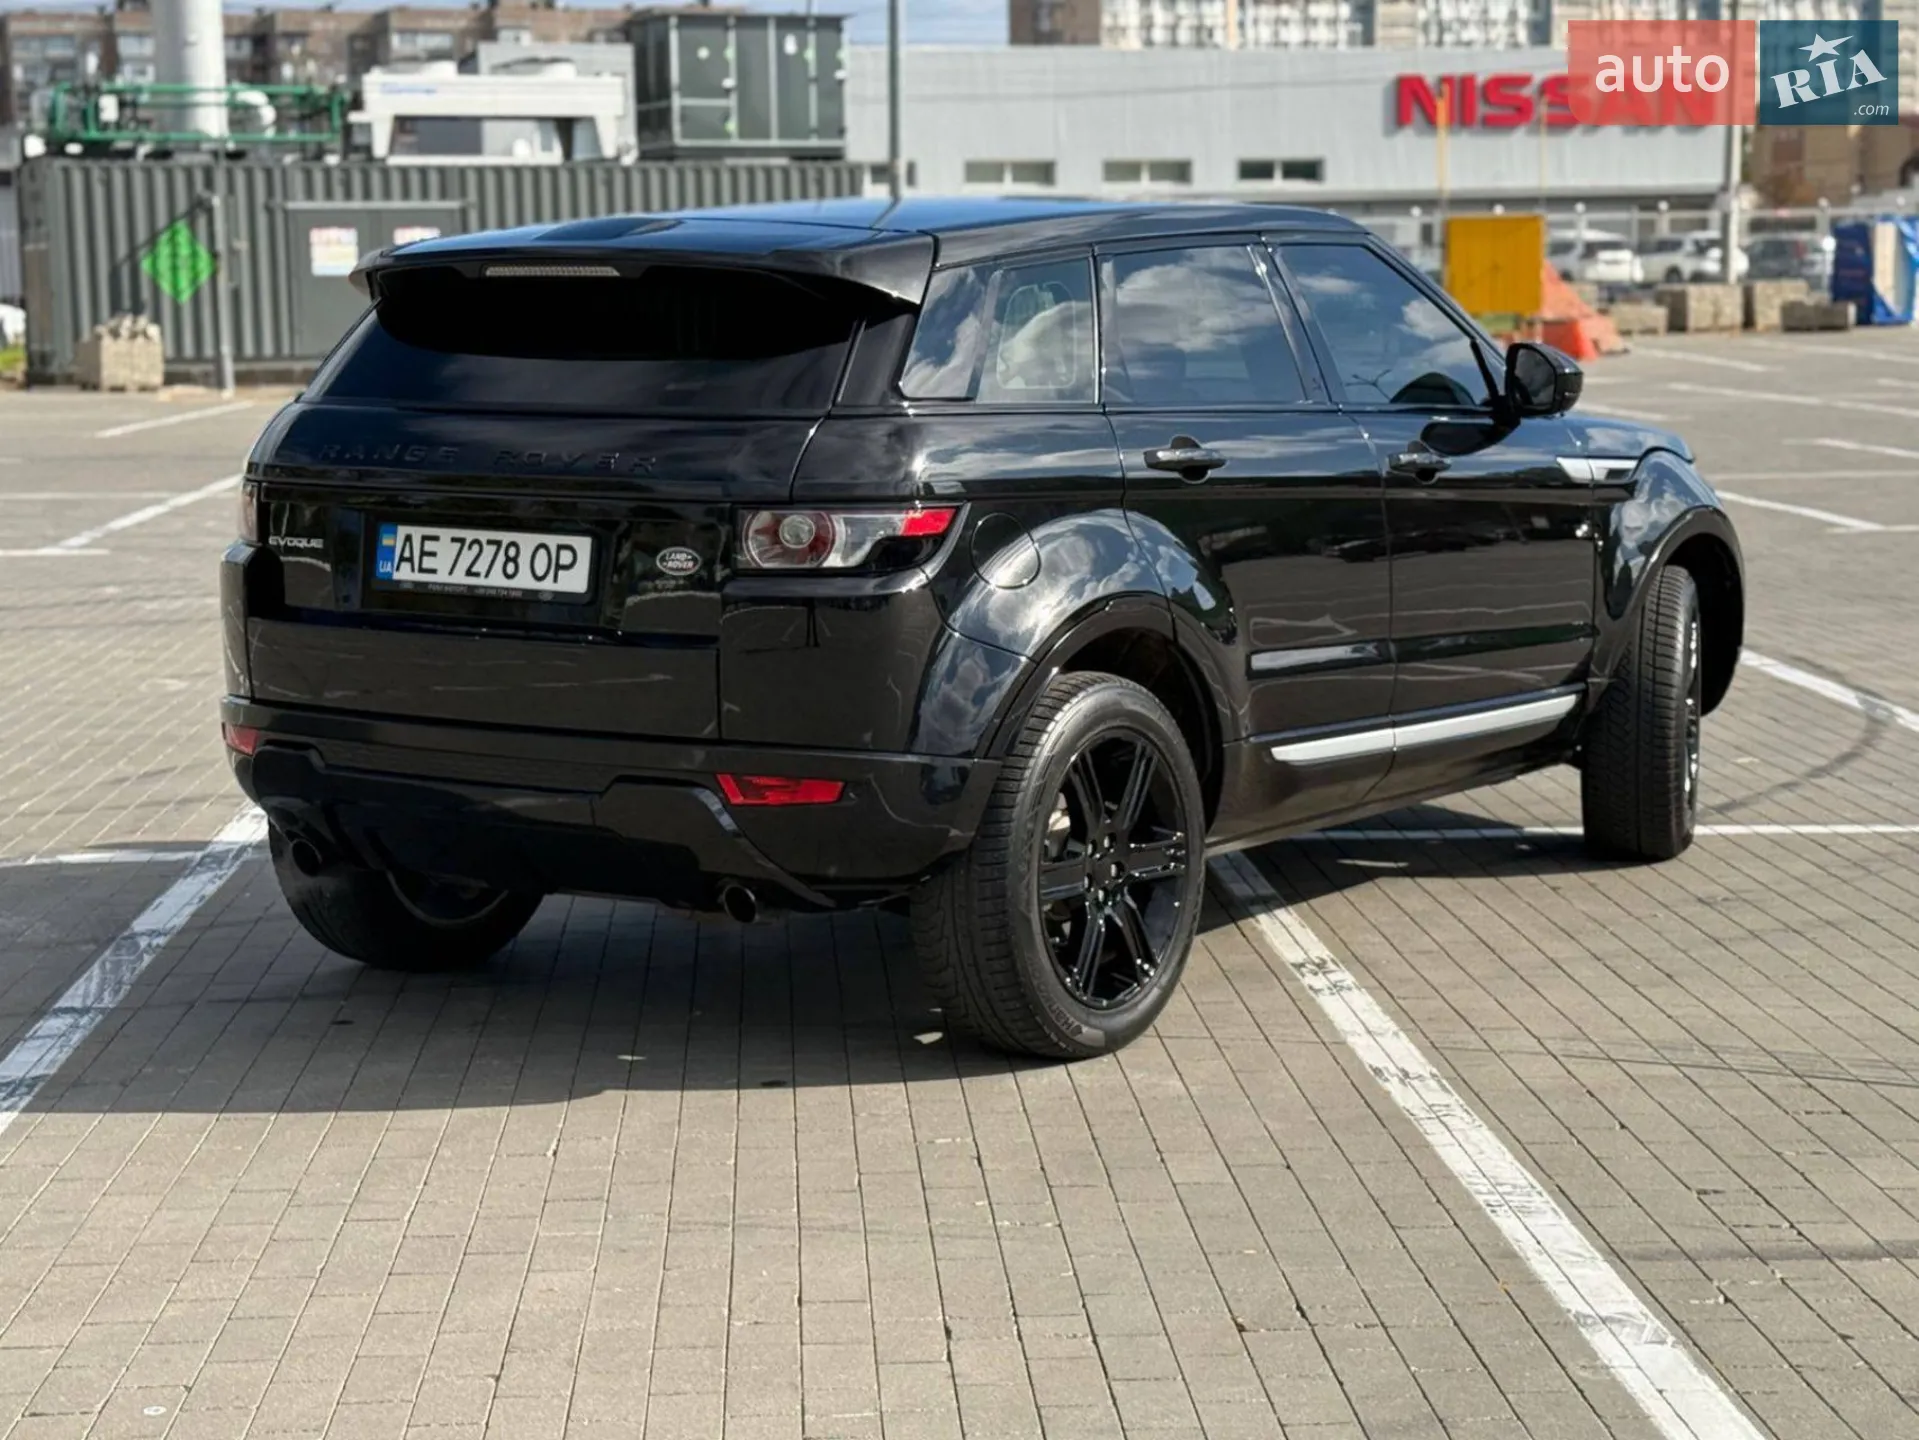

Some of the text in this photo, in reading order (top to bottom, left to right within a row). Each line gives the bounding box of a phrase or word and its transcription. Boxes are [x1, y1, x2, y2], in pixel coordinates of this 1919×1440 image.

[1394, 74, 1717, 127] NISSAN
[317, 444, 657, 473] RANGE ROVER
[268, 535, 324, 549] EVOQUE
[379, 560, 393, 573] UA
[396, 533, 578, 584] AE 7278 OP
